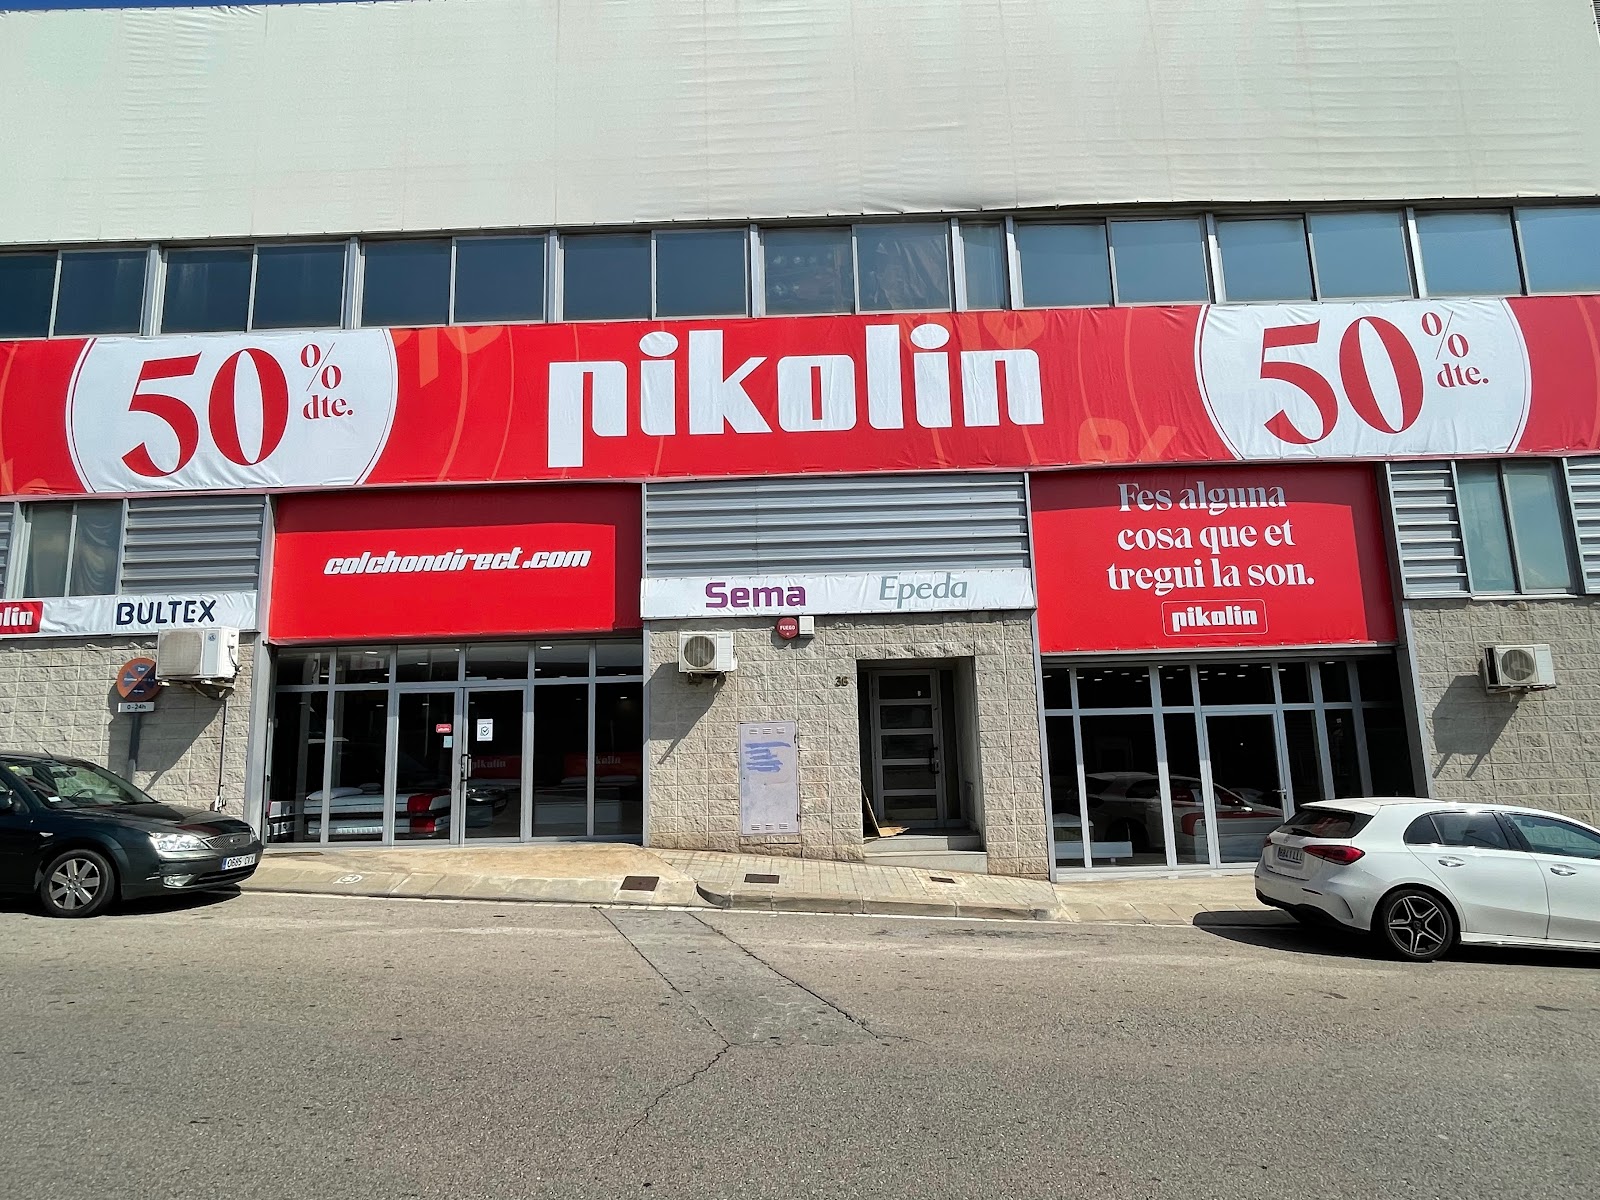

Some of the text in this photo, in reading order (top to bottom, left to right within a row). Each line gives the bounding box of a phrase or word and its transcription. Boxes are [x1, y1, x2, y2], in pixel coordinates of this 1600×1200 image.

[1261, 316, 1424, 444] 50
[1437, 363, 1489, 389] dte.
[122, 347, 289, 477] 50
[302, 395, 354, 420] dte.
[548, 323, 1044, 468] pikolin
[1117, 481, 1287, 516] Fes alguna
[1117, 519, 1296, 554] cosa que et
[323, 547, 592, 575] colchondirect.com
[1106, 558, 1315, 596] tregui la son.
[705, 581, 807, 609] Sema
[878, 572, 968, 609] Epeda
[116, 600, 217, 626] BULTEX
[1171, 605, 1258, 632] pikolin
